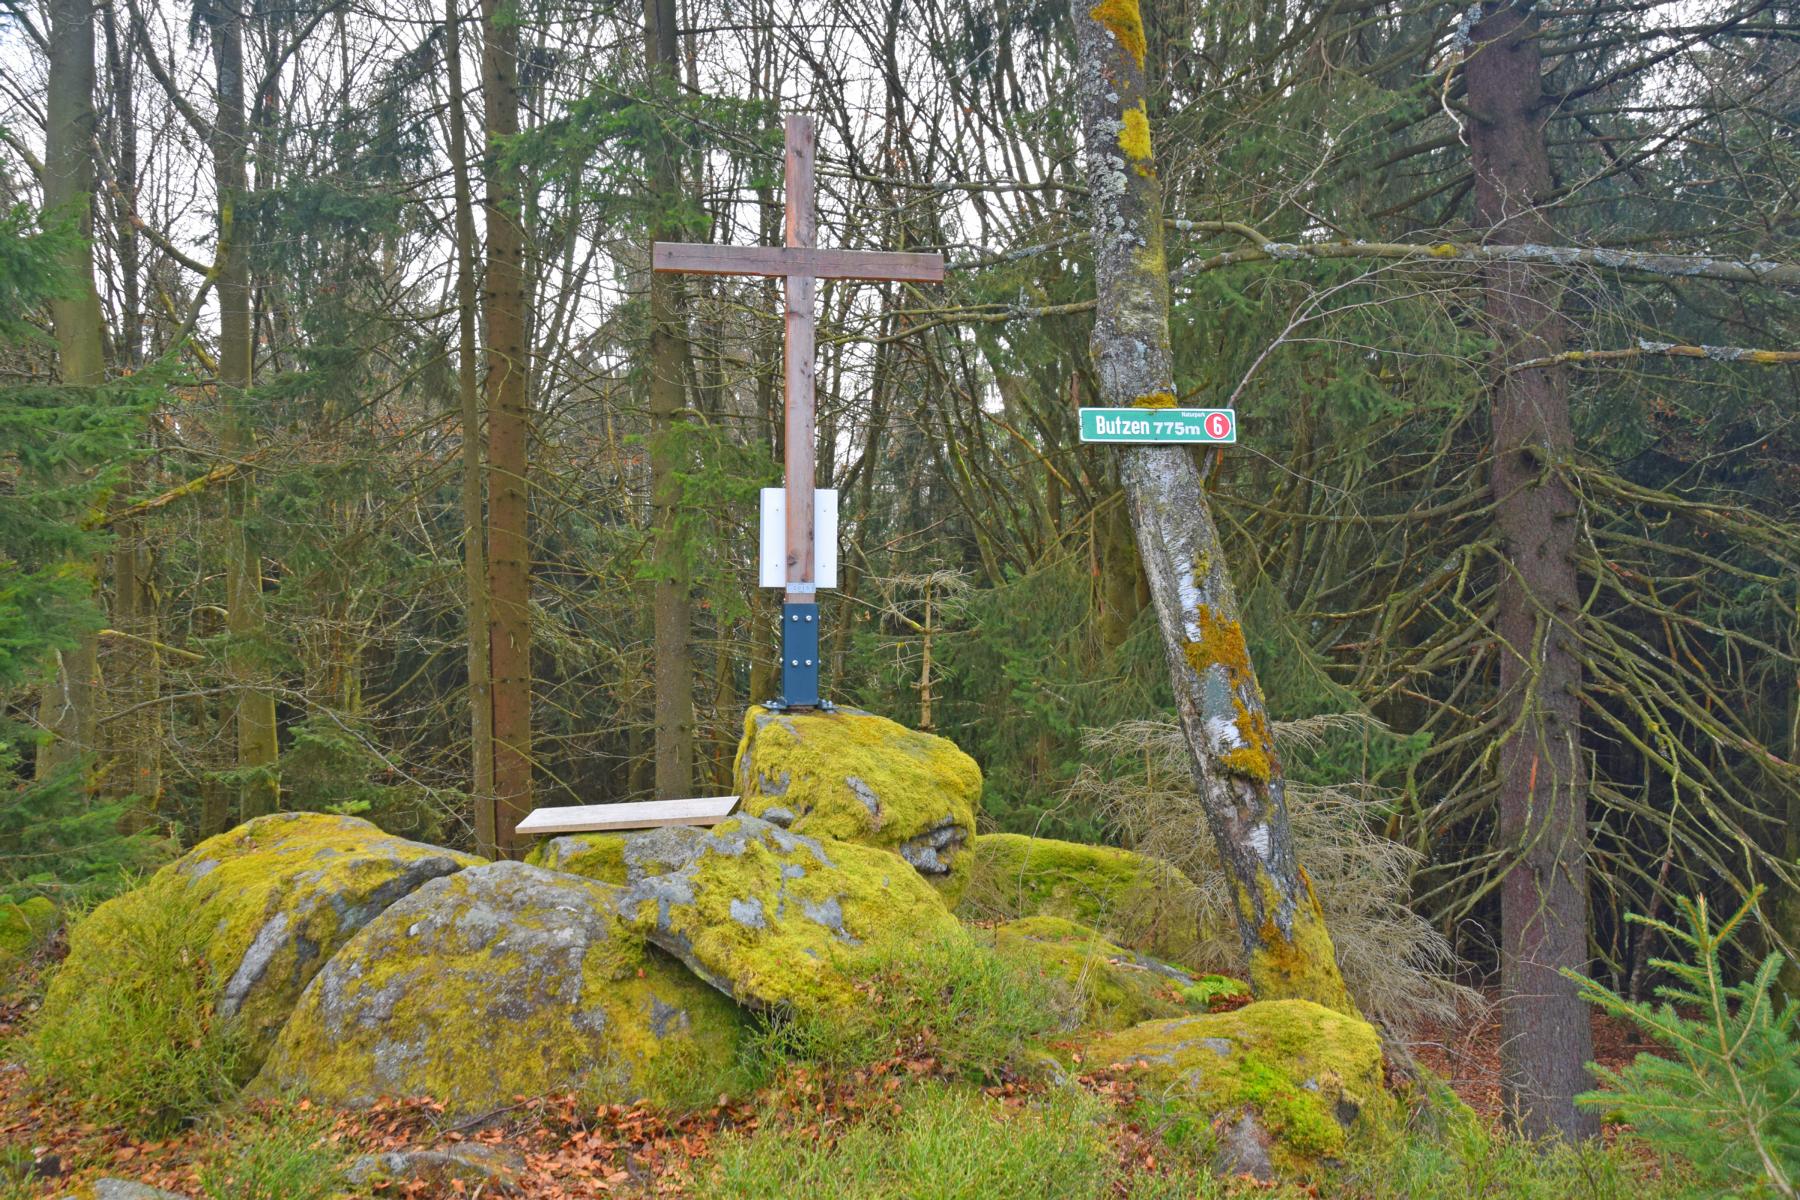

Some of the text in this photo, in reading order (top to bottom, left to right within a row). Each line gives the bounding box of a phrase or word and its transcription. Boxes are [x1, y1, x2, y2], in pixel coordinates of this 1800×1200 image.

[1096, 415, 1223, 436] Butzen 775m 6
